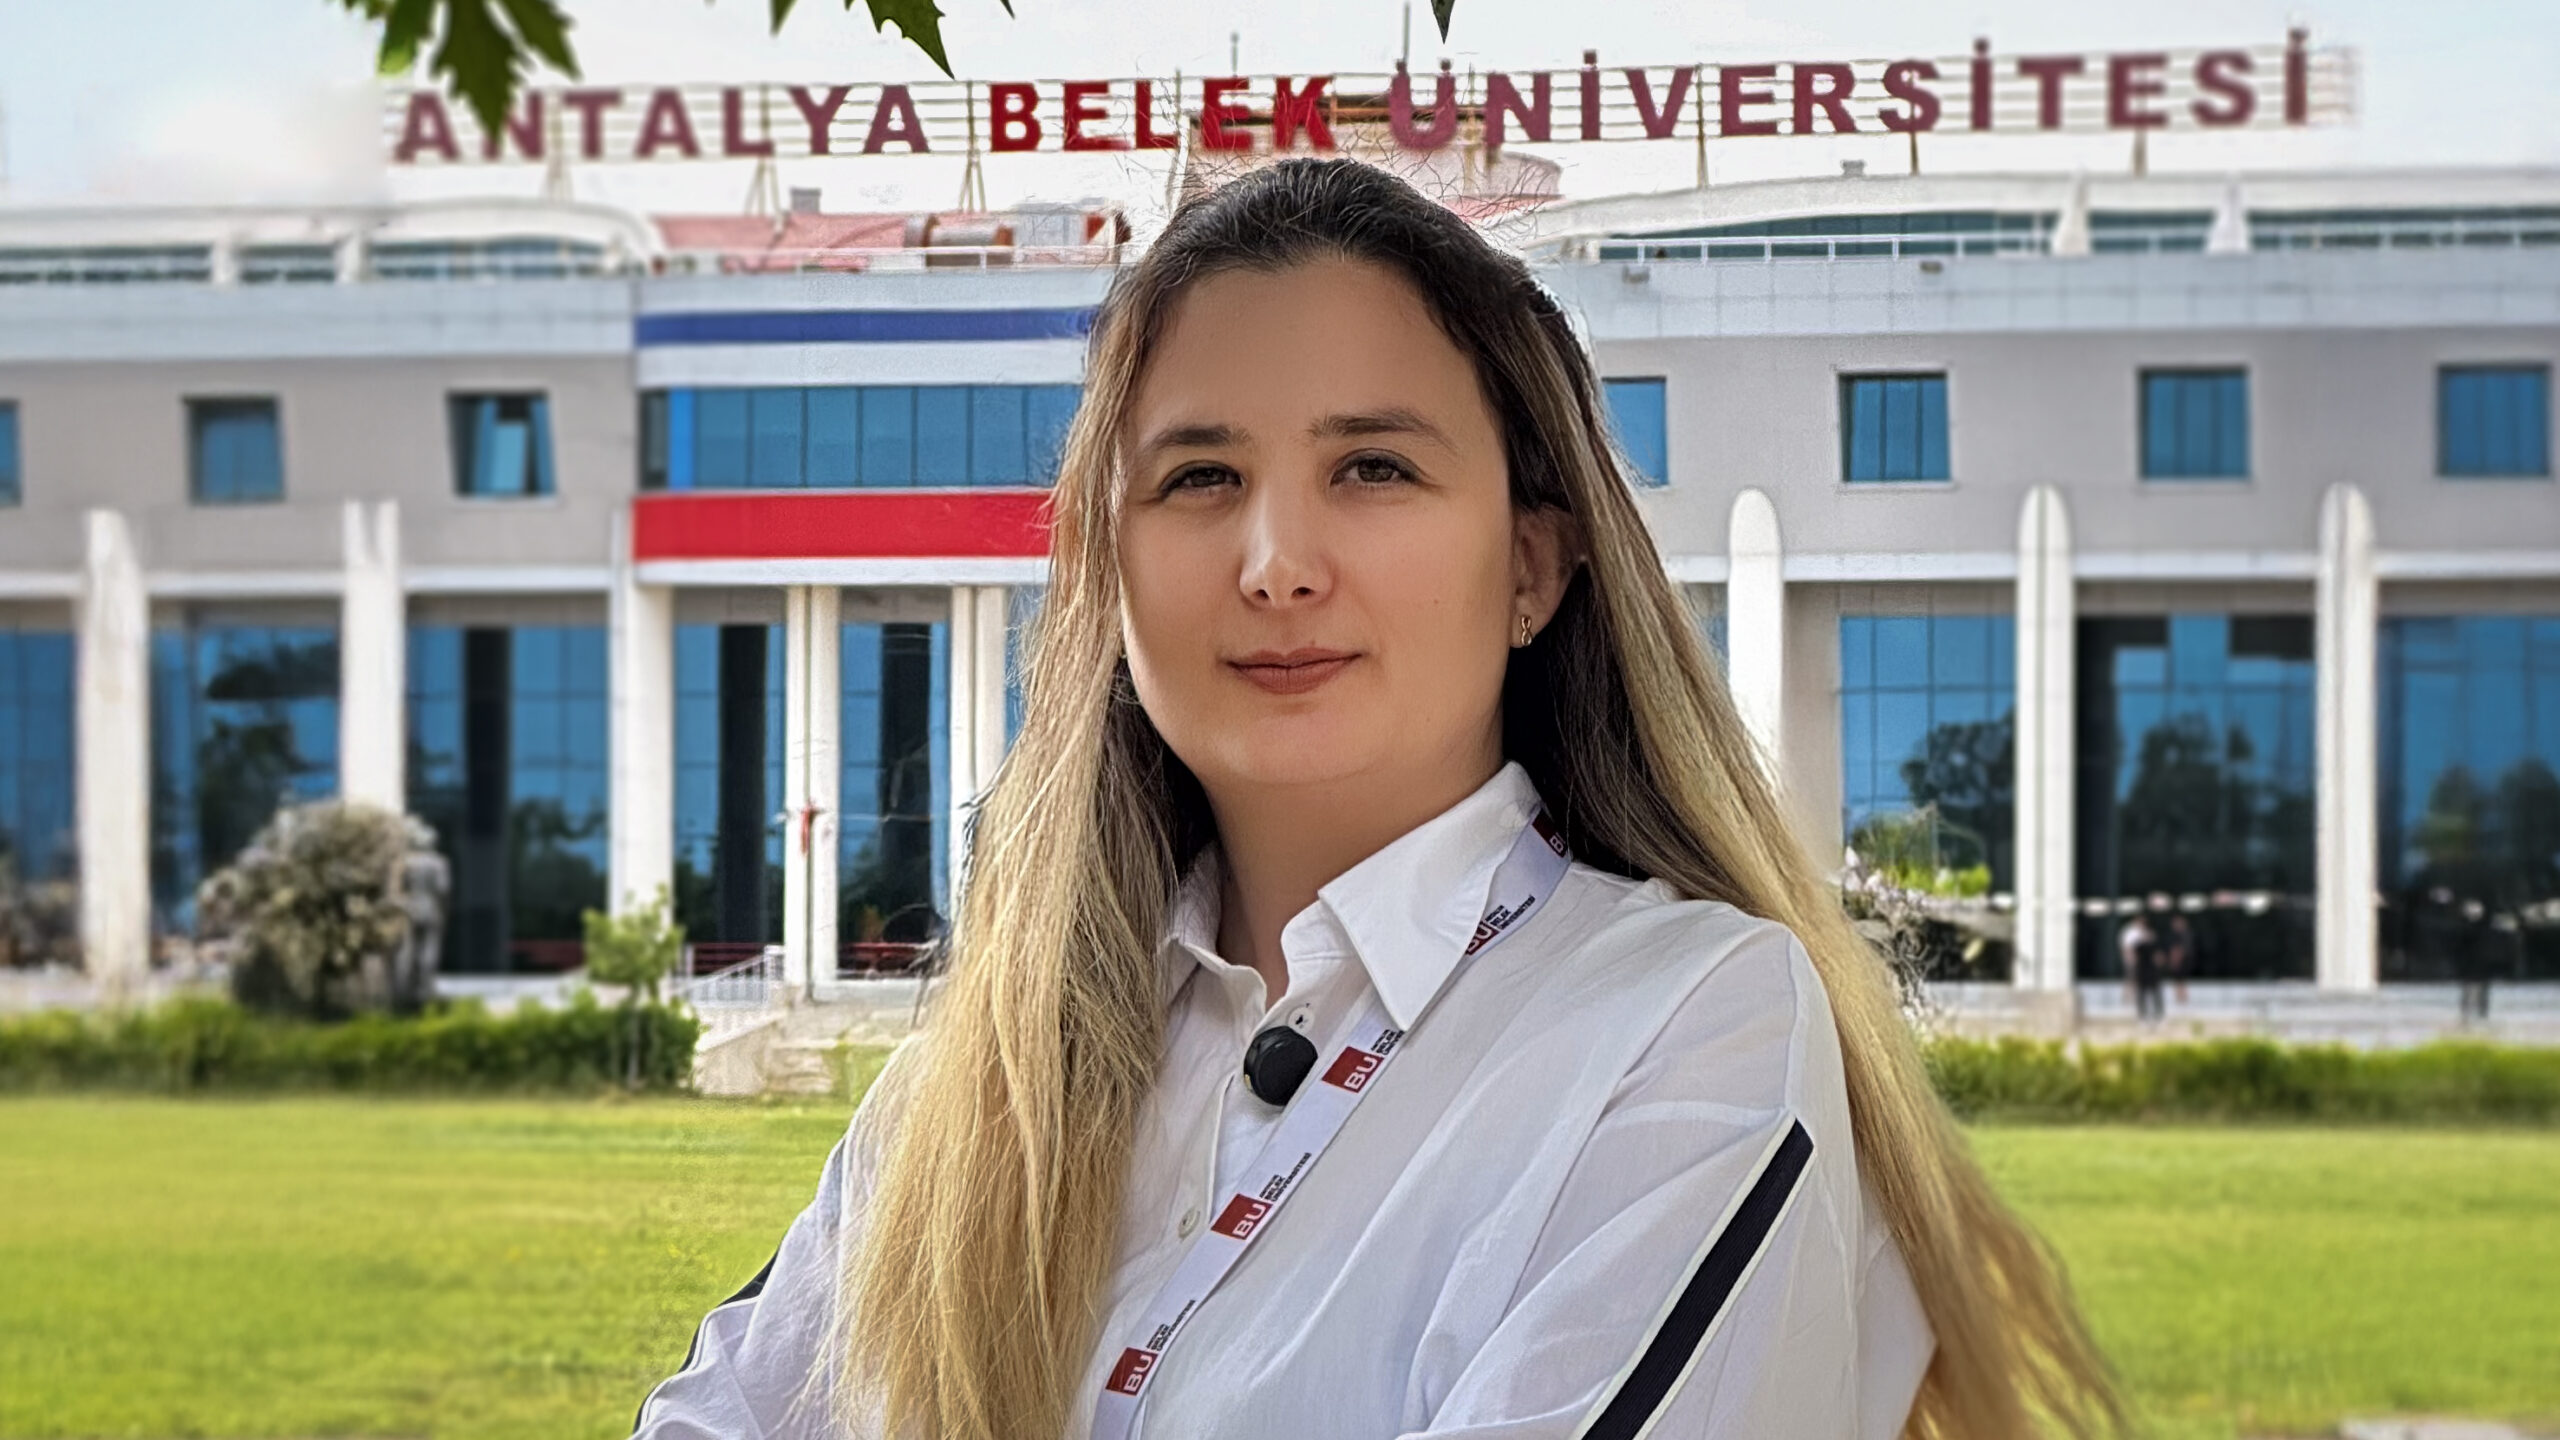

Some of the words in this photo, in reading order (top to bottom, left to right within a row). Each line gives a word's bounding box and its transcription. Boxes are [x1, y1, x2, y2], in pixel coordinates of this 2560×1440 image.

[394, 85, 930, 163] ANTALYA
[988, 74, 1337, 152] BELEK
[1388, 28, 2309, 152] ÜNİVERSİTESİ
[1343, 1056, 1378, 1090] BU
[1231, 1203, 1267, 1238] BU
[1123, 1355, 1153, 1392] BU
